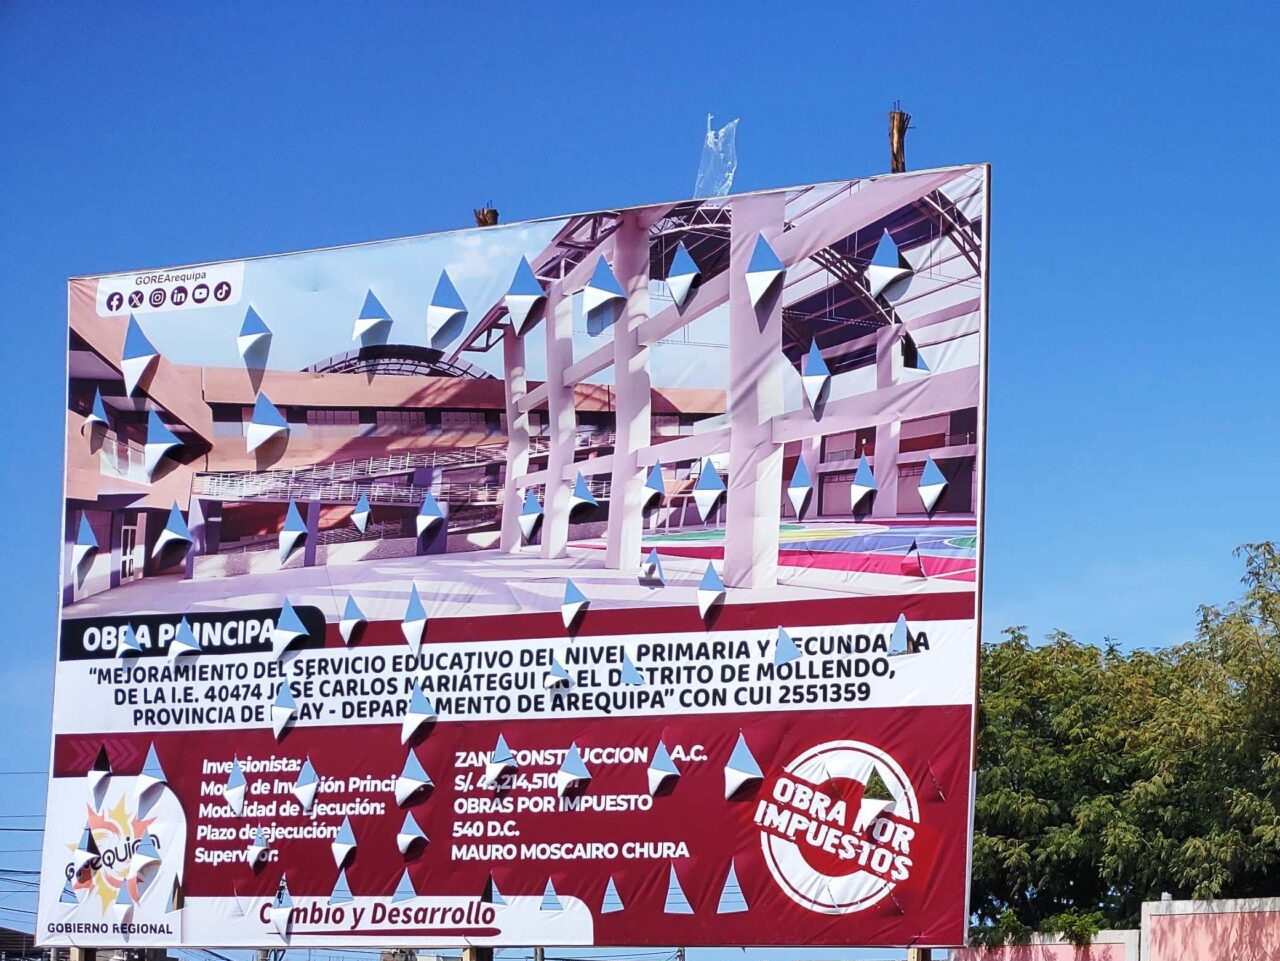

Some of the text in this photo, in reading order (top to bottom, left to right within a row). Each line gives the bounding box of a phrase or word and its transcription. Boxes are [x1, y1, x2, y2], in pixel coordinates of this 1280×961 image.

[135, 271, 207, 285] GOREArequipa
[254, 660, 287, 679] DEL
[293, 655, 386, 675] SERVICIO
[392, 650, 513, 672] EDUCATIVO
[637, 641, 751, 662] PRIMARIA
[757, 639, 770, 658] Y
[114, 688, 138, 705] DE
[144, 687, 166, 704] LA
[172, 686, 199, 704] I.E.
[204, 683, 262, 703] 40474
[319, 677, 398, 697] CARLOS
[577, 669, 601, 688] EL
[720, 663, 750, 683] DE
[757, 658, 896, 681] MOLLENDO,
[133, 706, 235, 726] PROVINCIA
[241, 704, 265, 723] DE
[518, 694, 545, 714] DE
[679, 687, 727, 708] CON
[734, 686, 771, 706] CUI
[778, 682, 871, 704] 2551359
[251, 779, 270, 795] de
[279, 800, 299, 816] de
[454, 794, 653, 814] OBRAS POR IMPUESTO
[773, 777, 847, 826] OBRA
[197, 824, 236, 841] Plazo
[452, 820, 520, 838] 540 D.C.
[753, 799, 913, 881] IMPUESTOS
[451, 841, 690, 861] MAURO MOSCAIRO CHURA
[259, 901, 496, 930] Cmbio y Desarrollo
[47, 923, 109, 934] GOBIERNO
